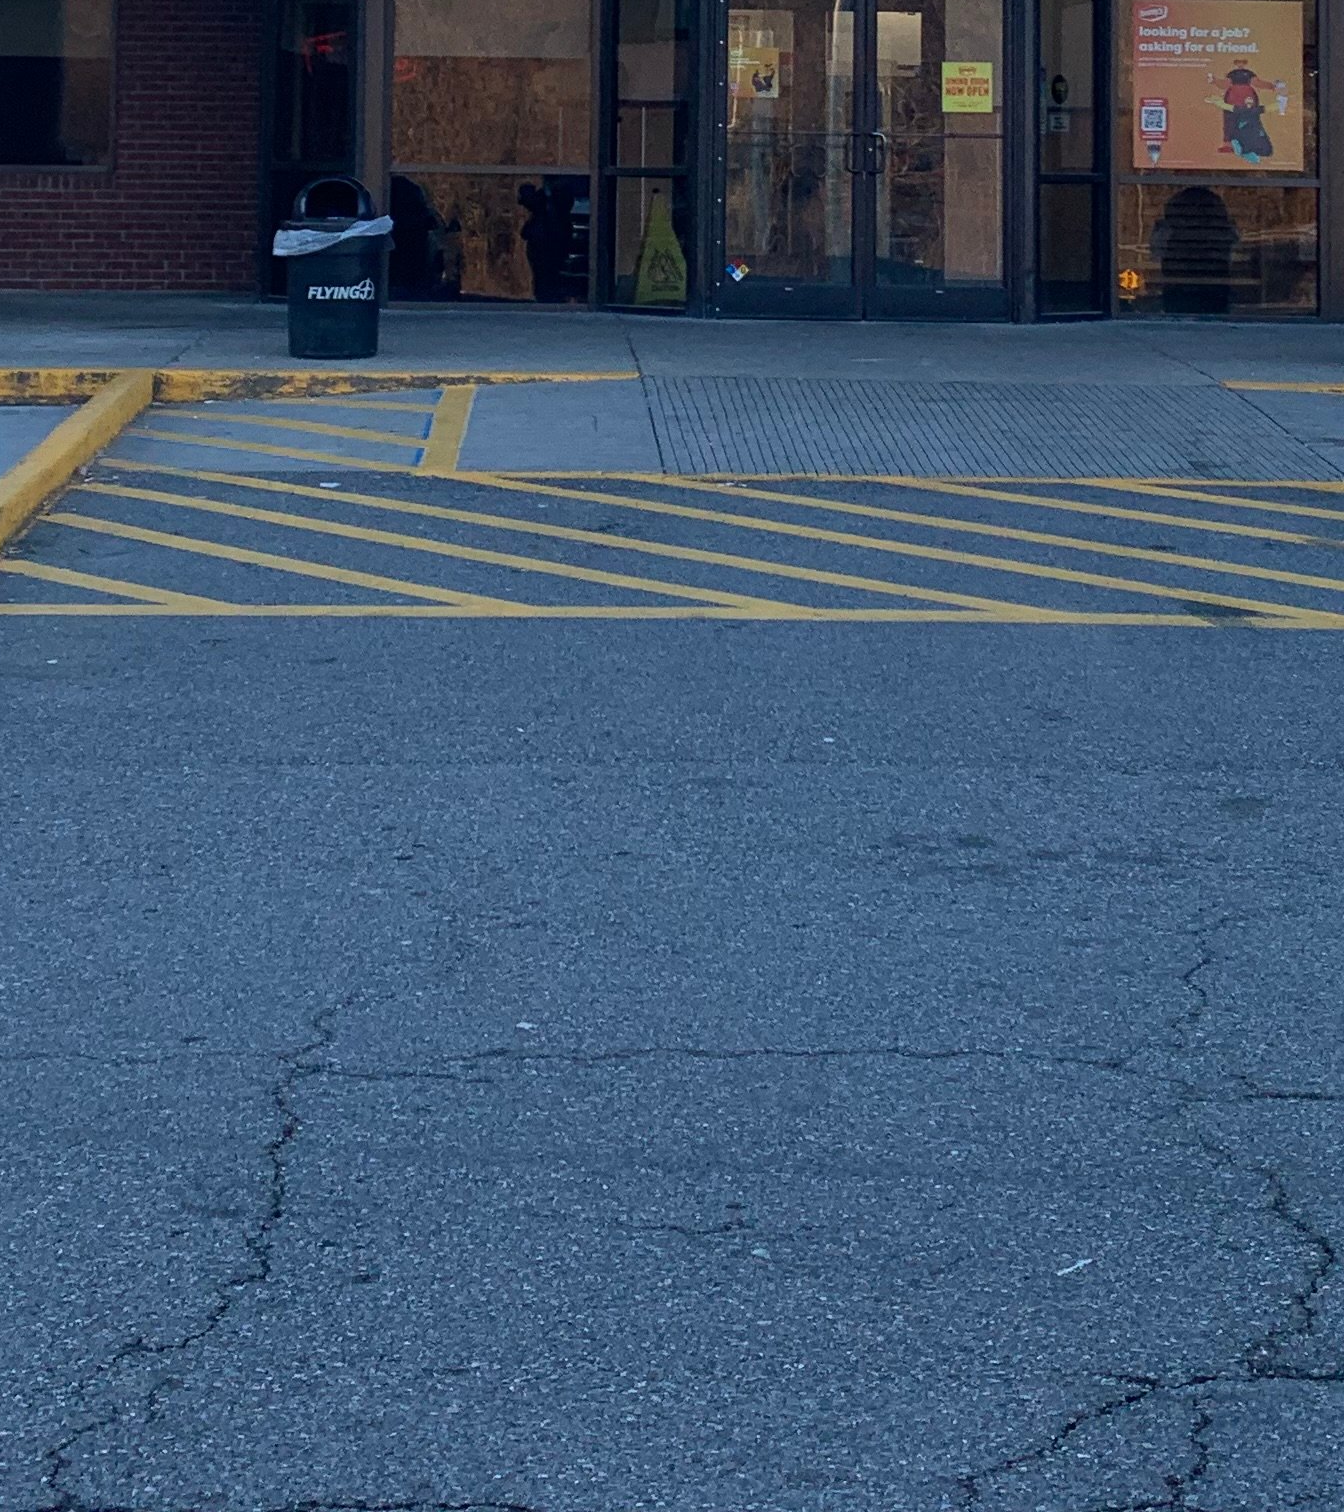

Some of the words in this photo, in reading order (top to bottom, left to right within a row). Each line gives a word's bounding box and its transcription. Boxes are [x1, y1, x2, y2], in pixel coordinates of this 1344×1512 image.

[1138, 26, 1188, 40] looking
[1189, 26, 1209, 38] for
[1210, 29, 1220, 38] a
[1220, 27, 1250, 40] job?
[1138, 42, 1183, 55] asking
[1184, 41, 1203, 53] for
[1205, 44, 1215, 53] a
[1216, 41, 1260, 54] friend.
[946, 87, 965, 96] NOW
[967, 87, 989, 96] OPEN
